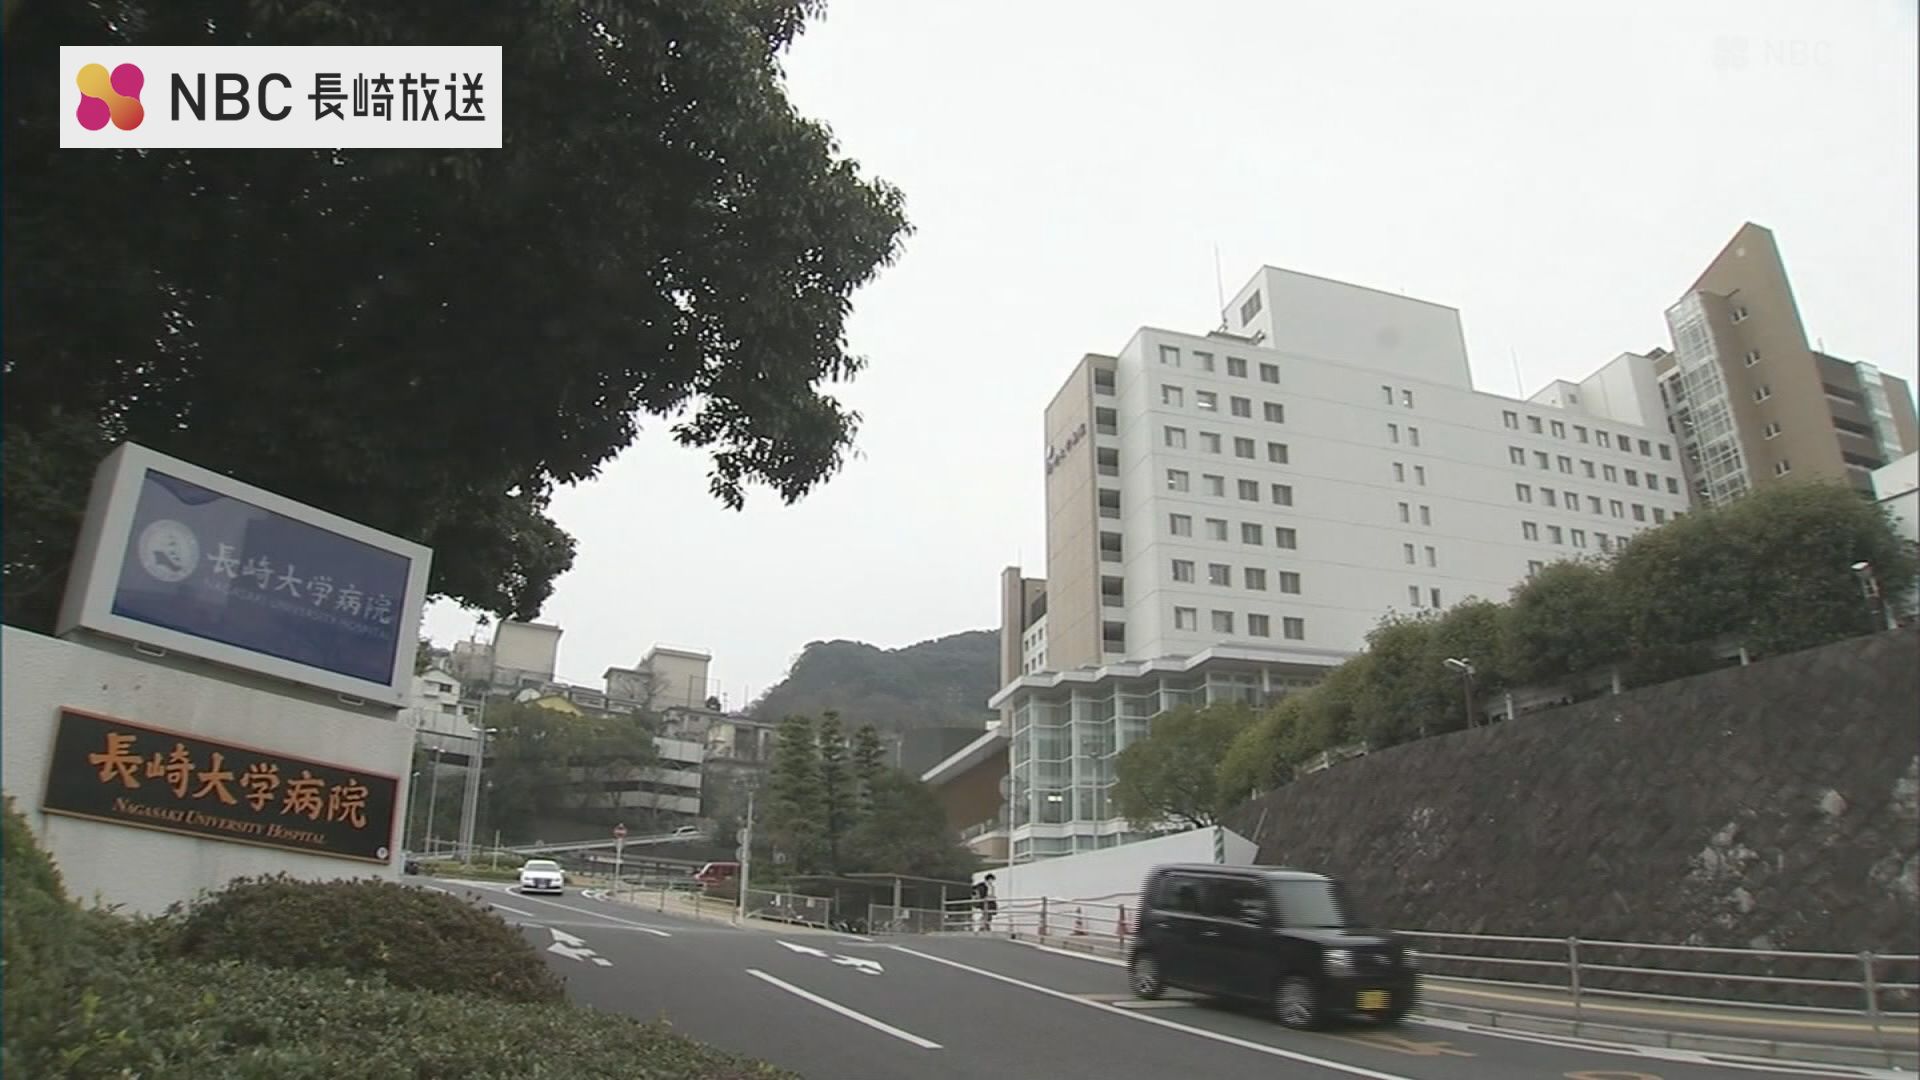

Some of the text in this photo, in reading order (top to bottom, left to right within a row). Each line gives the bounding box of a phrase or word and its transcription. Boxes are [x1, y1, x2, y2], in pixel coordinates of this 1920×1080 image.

[207, 542, 393, 625] 長崎大学病院
[88, 732, 369, 829] 長崎大学病院
[112, 797, 328, 845] NAGASAKI UNIVERSITY HOSPITAL
